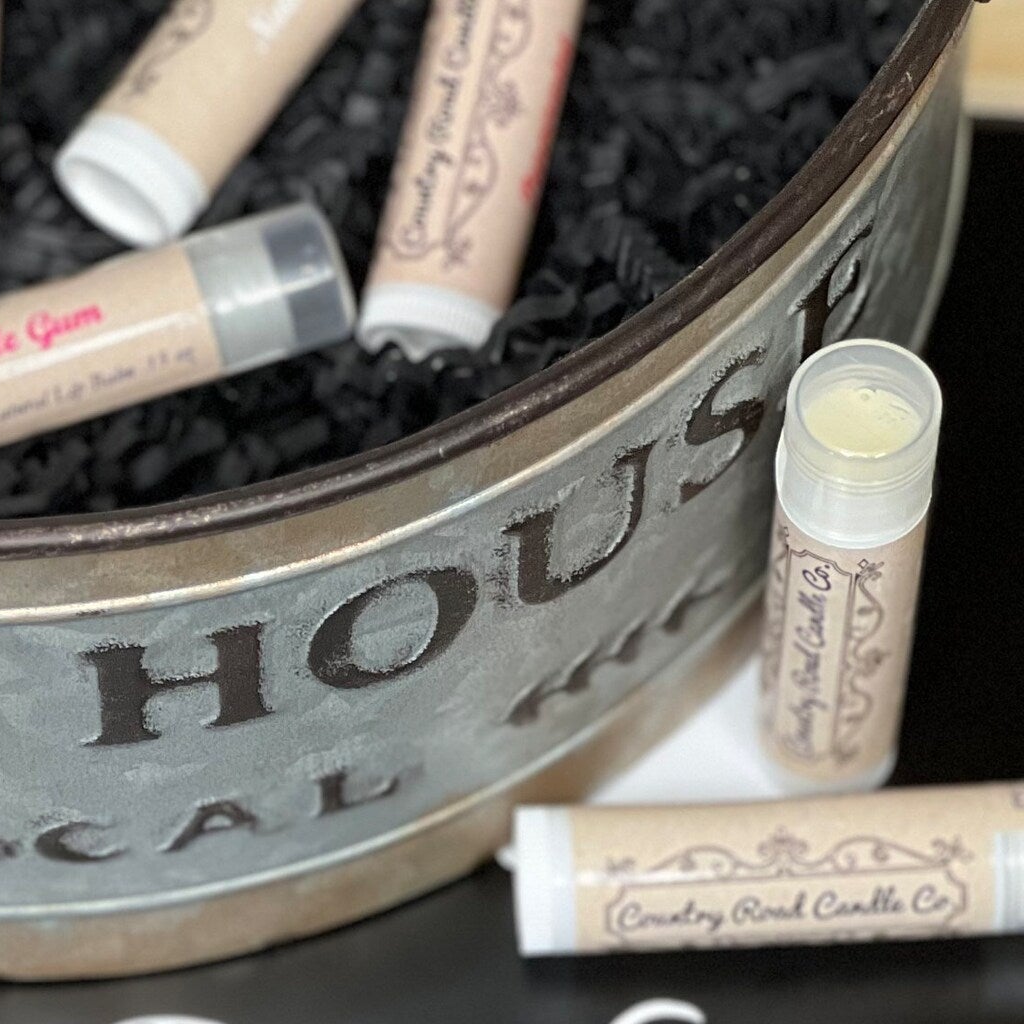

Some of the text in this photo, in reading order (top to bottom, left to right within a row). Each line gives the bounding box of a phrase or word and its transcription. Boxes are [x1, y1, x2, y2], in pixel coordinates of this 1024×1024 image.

[26, 304, 104, 351] Gum
[802, 563, 832, 592] Co.
[617, 900, 724, 933] Country
[732, 889, 805, 926] Road
[813, 879, 905, 920] Candle
